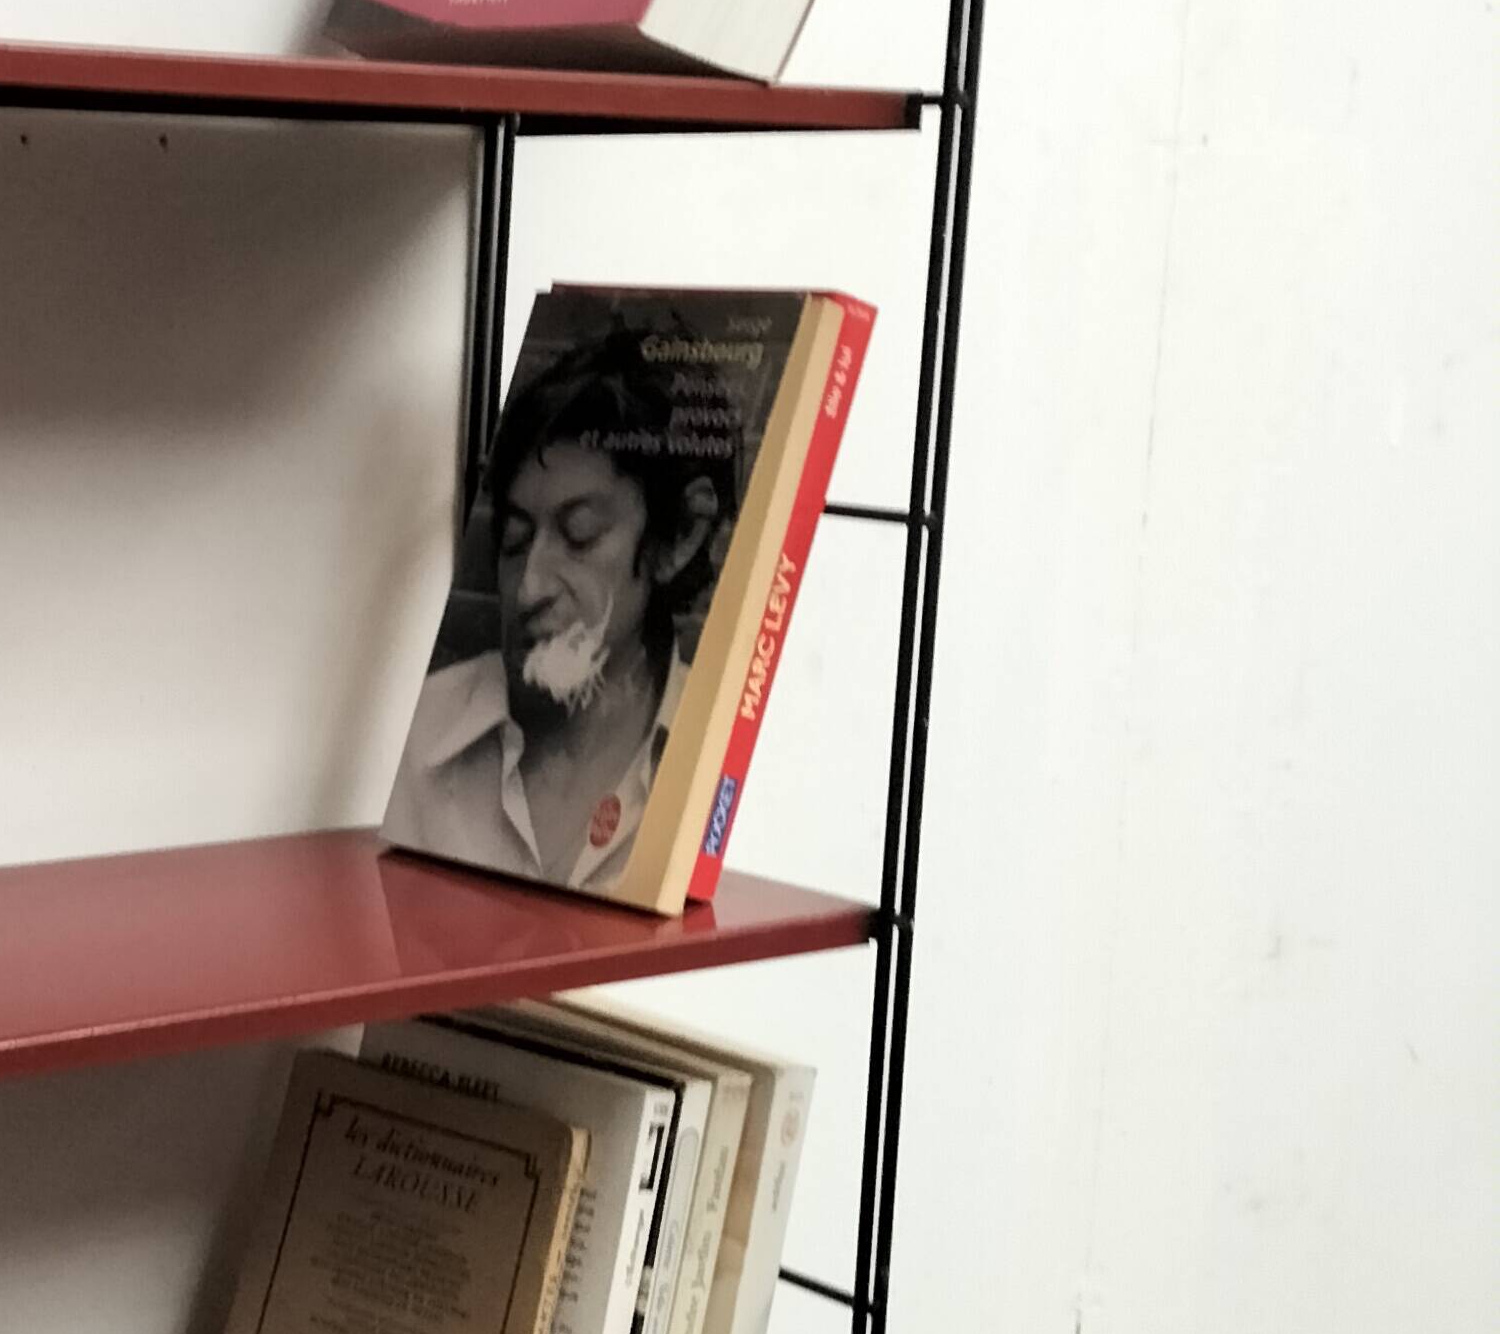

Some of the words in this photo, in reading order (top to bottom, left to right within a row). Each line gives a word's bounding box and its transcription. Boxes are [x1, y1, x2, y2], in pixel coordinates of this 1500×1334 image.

[641, 334, 765, 370] Gainsbourg
[739, 633, 776, 721] MARC
[764, 552, 798, 631] LEVY
[353, 1153, 479, 1213] LAROUSSE
